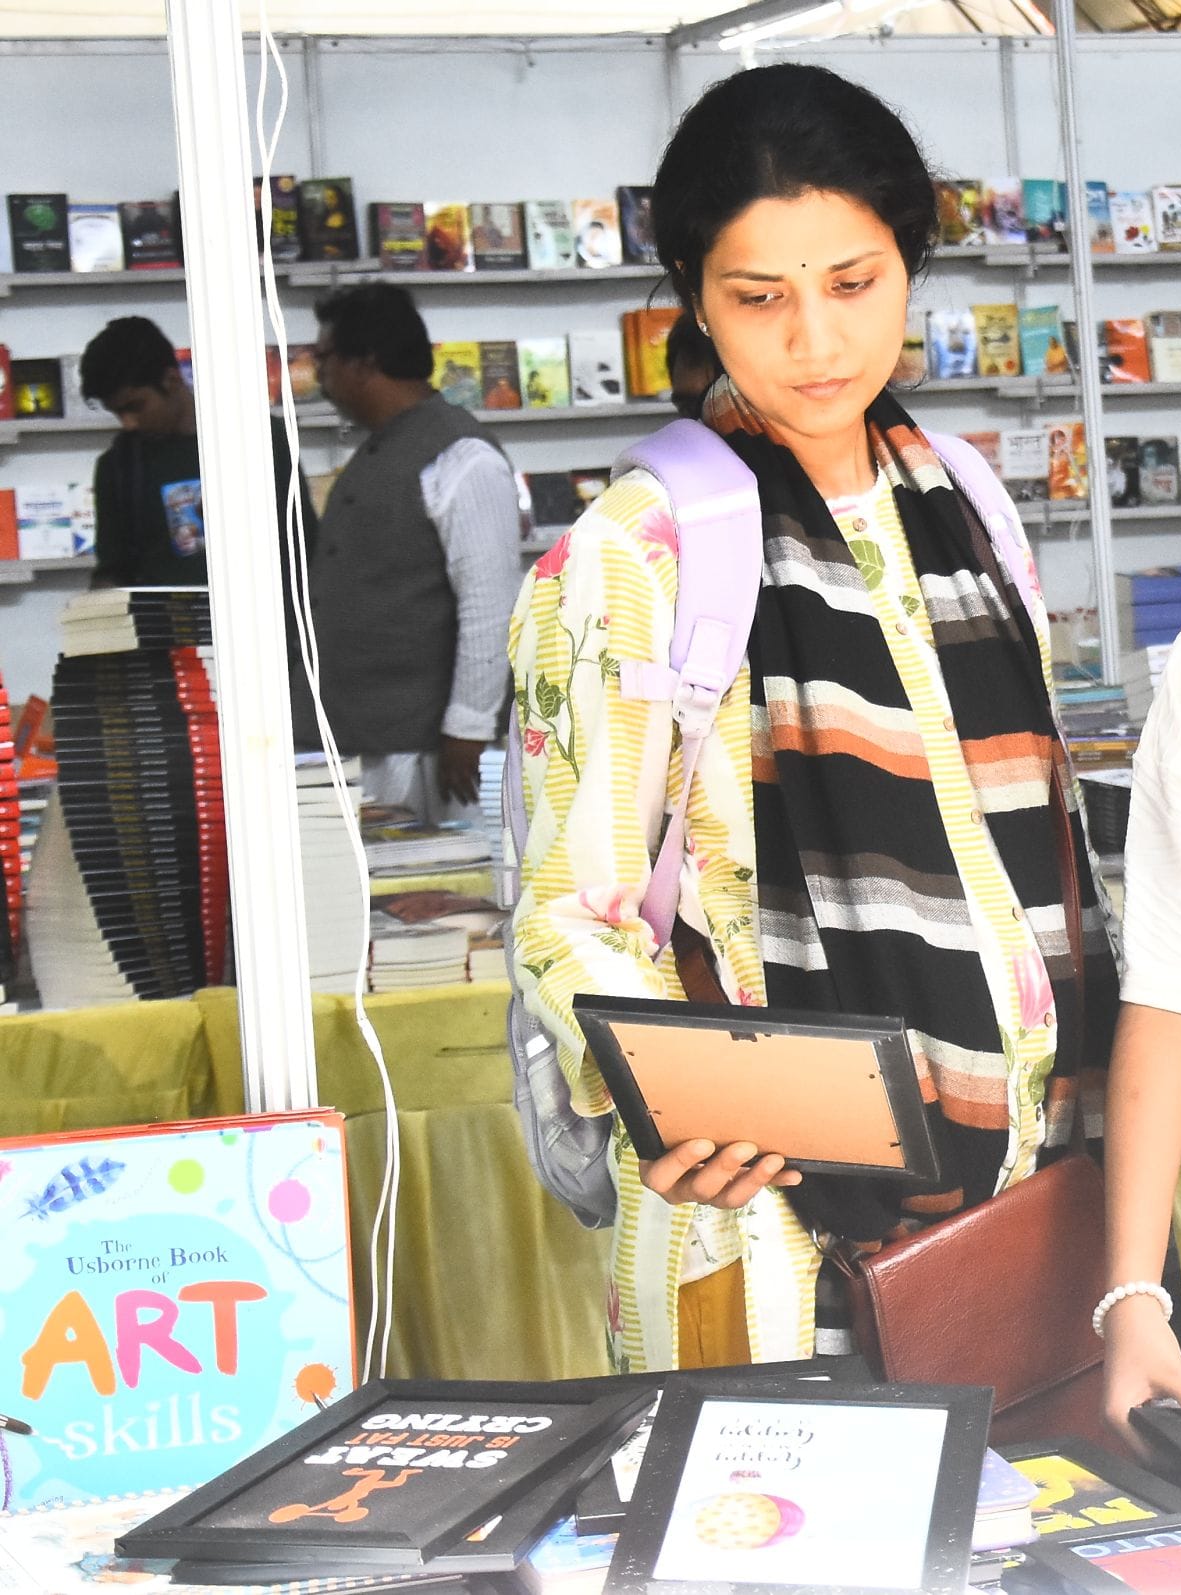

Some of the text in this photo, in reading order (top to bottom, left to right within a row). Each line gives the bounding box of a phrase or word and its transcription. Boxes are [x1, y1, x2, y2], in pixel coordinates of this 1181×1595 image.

[100, 1240, 133, 1254] The
[66, 1246, 229, 1275] Usborne Book
[151, 1271, 170, 1285] of
[21, 1280, 268, 1401] ART
[62, 1392, 242, 1461] skills
[361, 1413, 554, 1433] CRYING
[344, 1432, 521, 1449] IS JUST FAT
[304, 1446, 509, 1469] SWEAT
